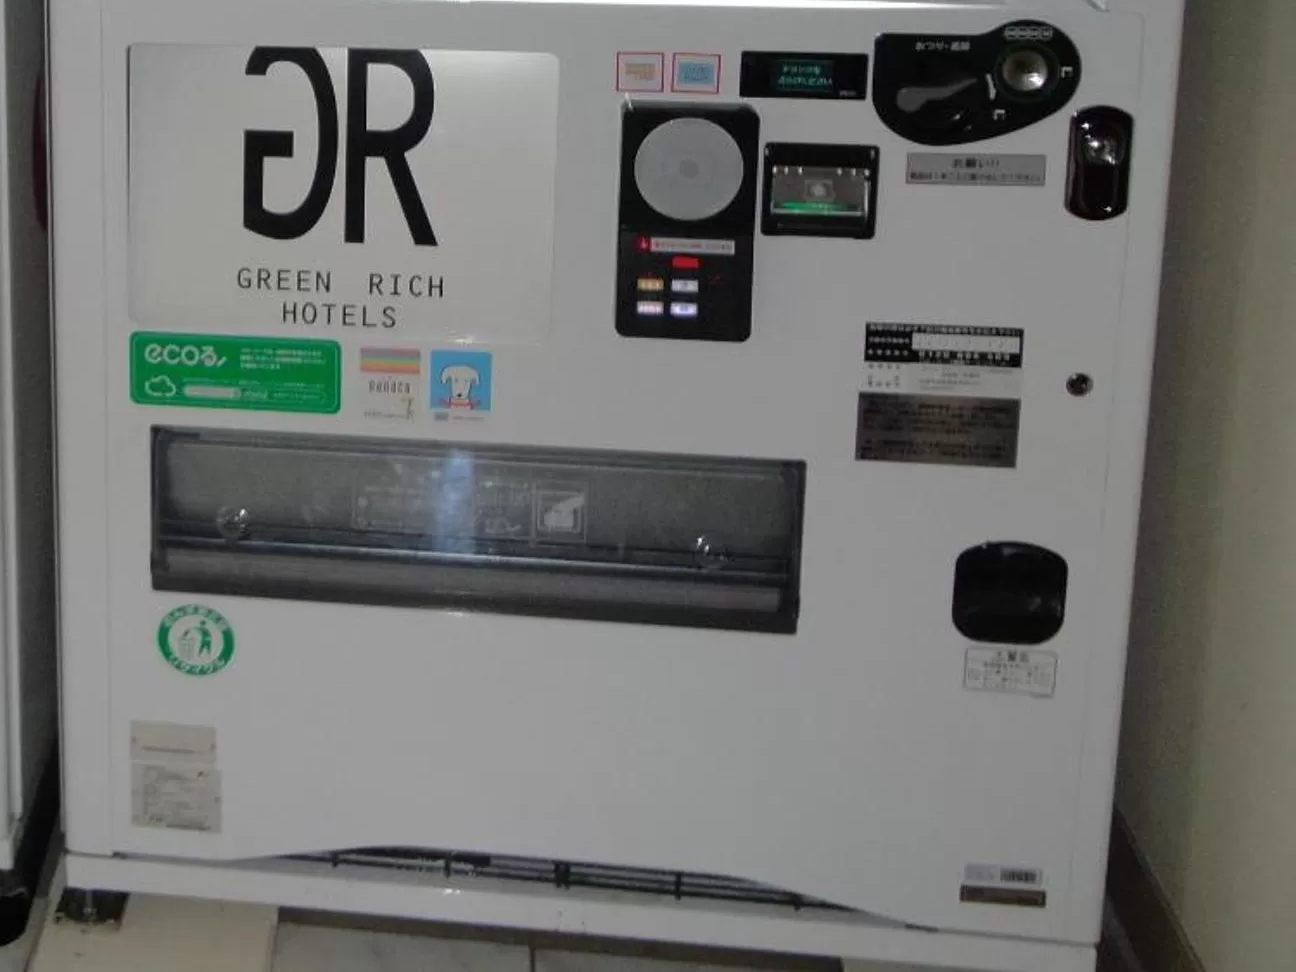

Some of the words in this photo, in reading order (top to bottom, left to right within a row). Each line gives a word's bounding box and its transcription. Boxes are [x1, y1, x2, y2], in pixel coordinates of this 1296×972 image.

[236, 267, 333, 293] GREEN
[368, 272, 444, 299] RICH
[282, 302, 397, 329] HOTELS
